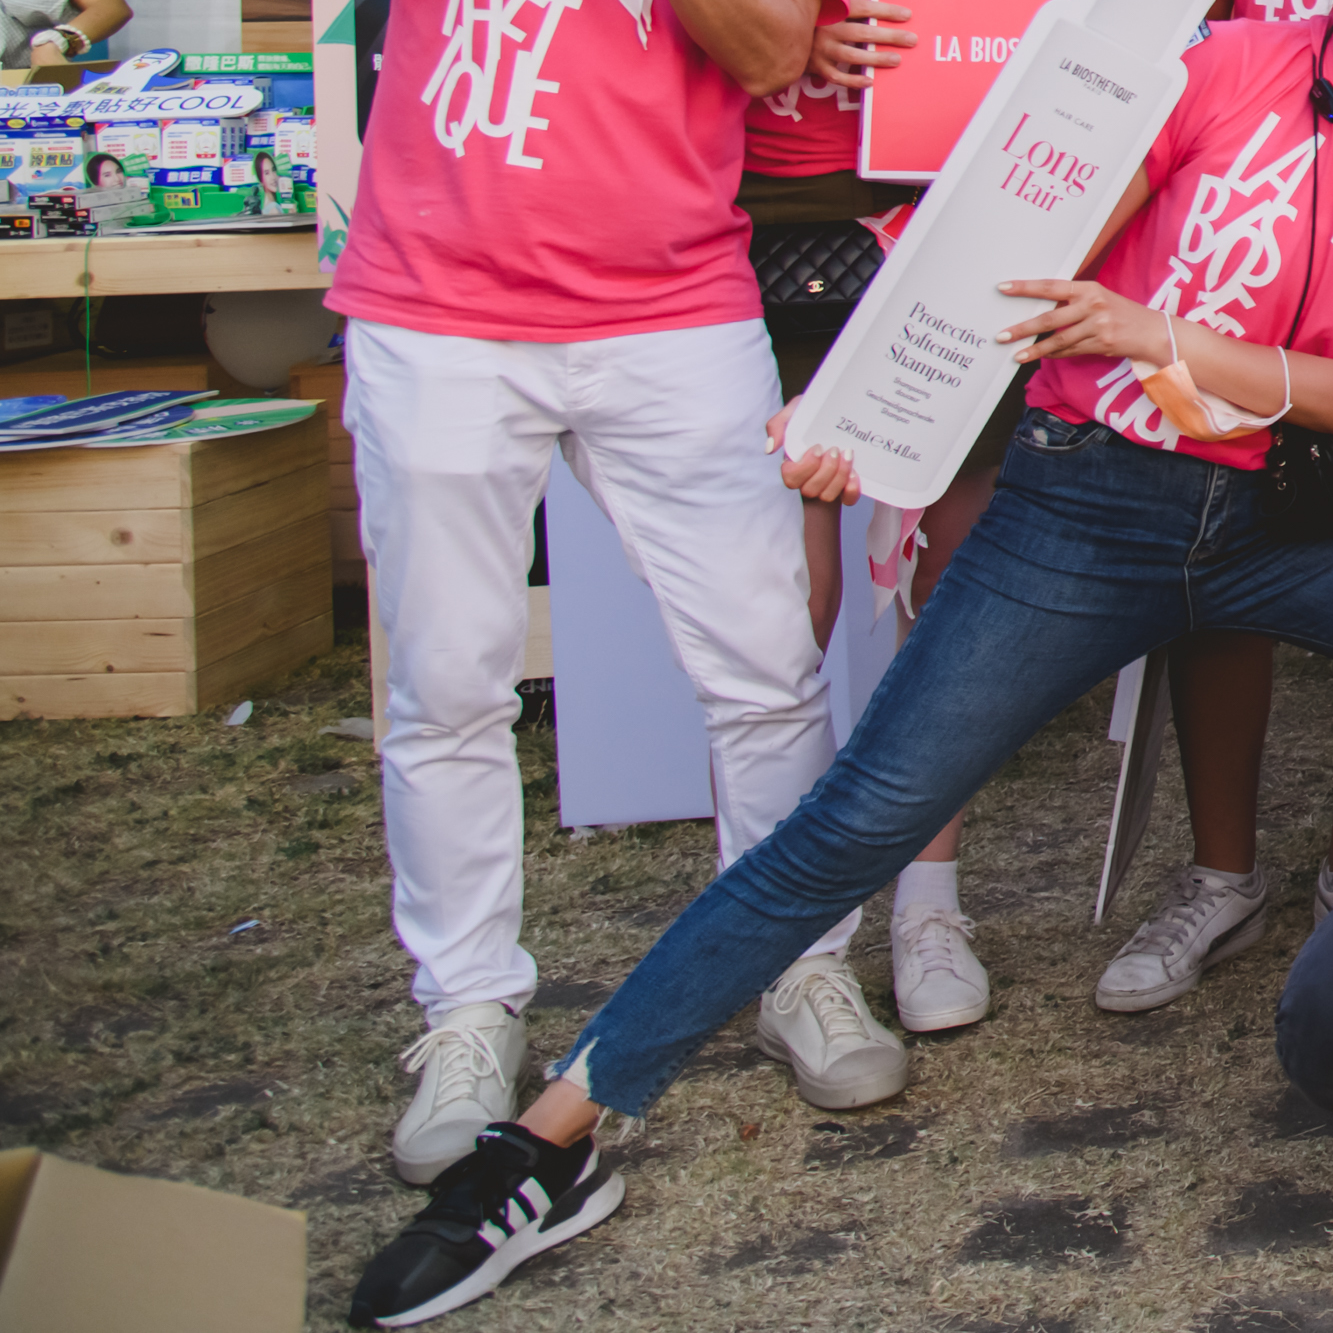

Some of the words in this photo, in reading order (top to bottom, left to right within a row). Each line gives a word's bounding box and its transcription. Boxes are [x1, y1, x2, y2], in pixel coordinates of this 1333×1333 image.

[935, 35, 961, 63] LA
[1059, 57, 1071, 71] LA
[1054, 108, 1073, 122] HAIR
[1074, 118, 1095, 132] CARE
[1001, 112, 1099, 198] Long
[1213, 111, 1326, 198] LA
[1000, 163, 1064, 212] Hair
[899, 323, 974, 371] Softening
[908, 301, 987, 349] Protective
[885, 343, 961, 388] Shampoo
[836, 417, 857, 435] 250
[855, 428, 871, 442] ml
[883, 439, 901, 454] 8.4
